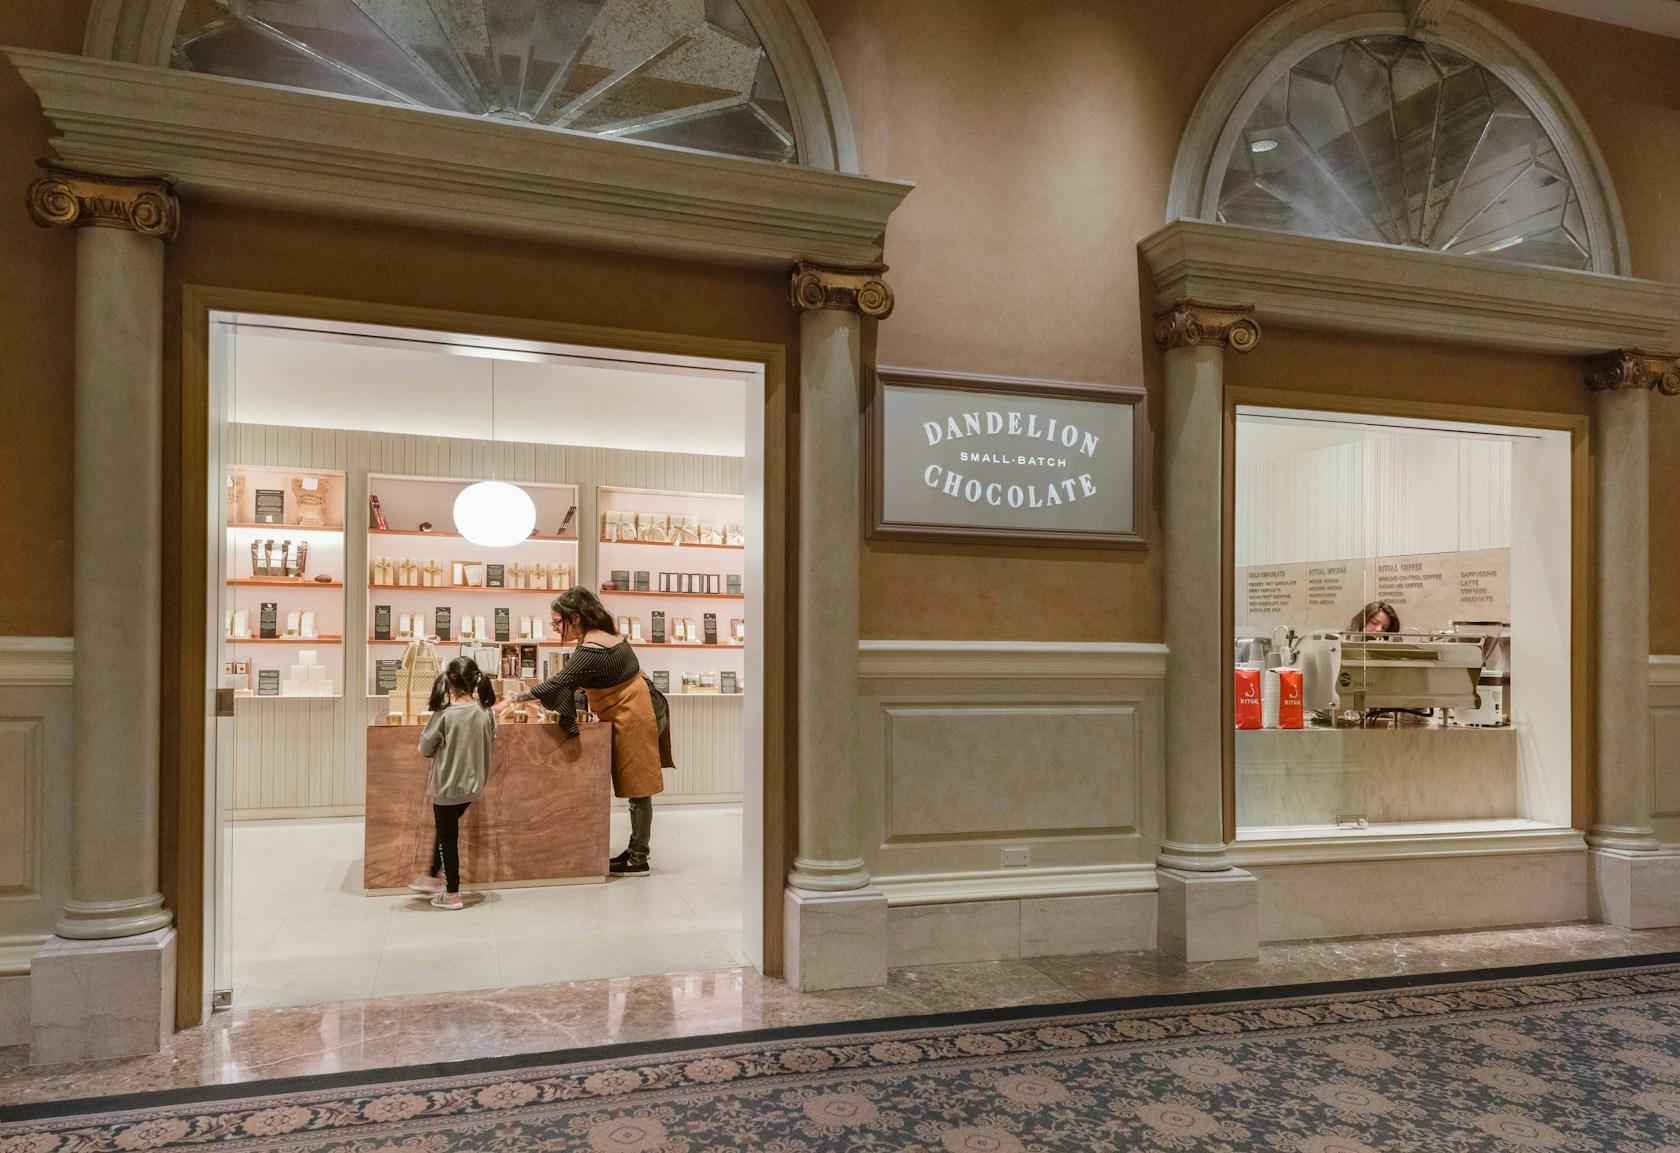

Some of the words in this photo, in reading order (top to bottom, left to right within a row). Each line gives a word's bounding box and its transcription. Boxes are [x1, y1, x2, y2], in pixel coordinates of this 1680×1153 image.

[922, 411, 1099, 457] DANDELION
[924, 464, 1097, 508] CHOCOLATE
[1401, 563, 1423, 571] COFFEE
[1460, 570, 1497, 578] CAPPUCCINO
